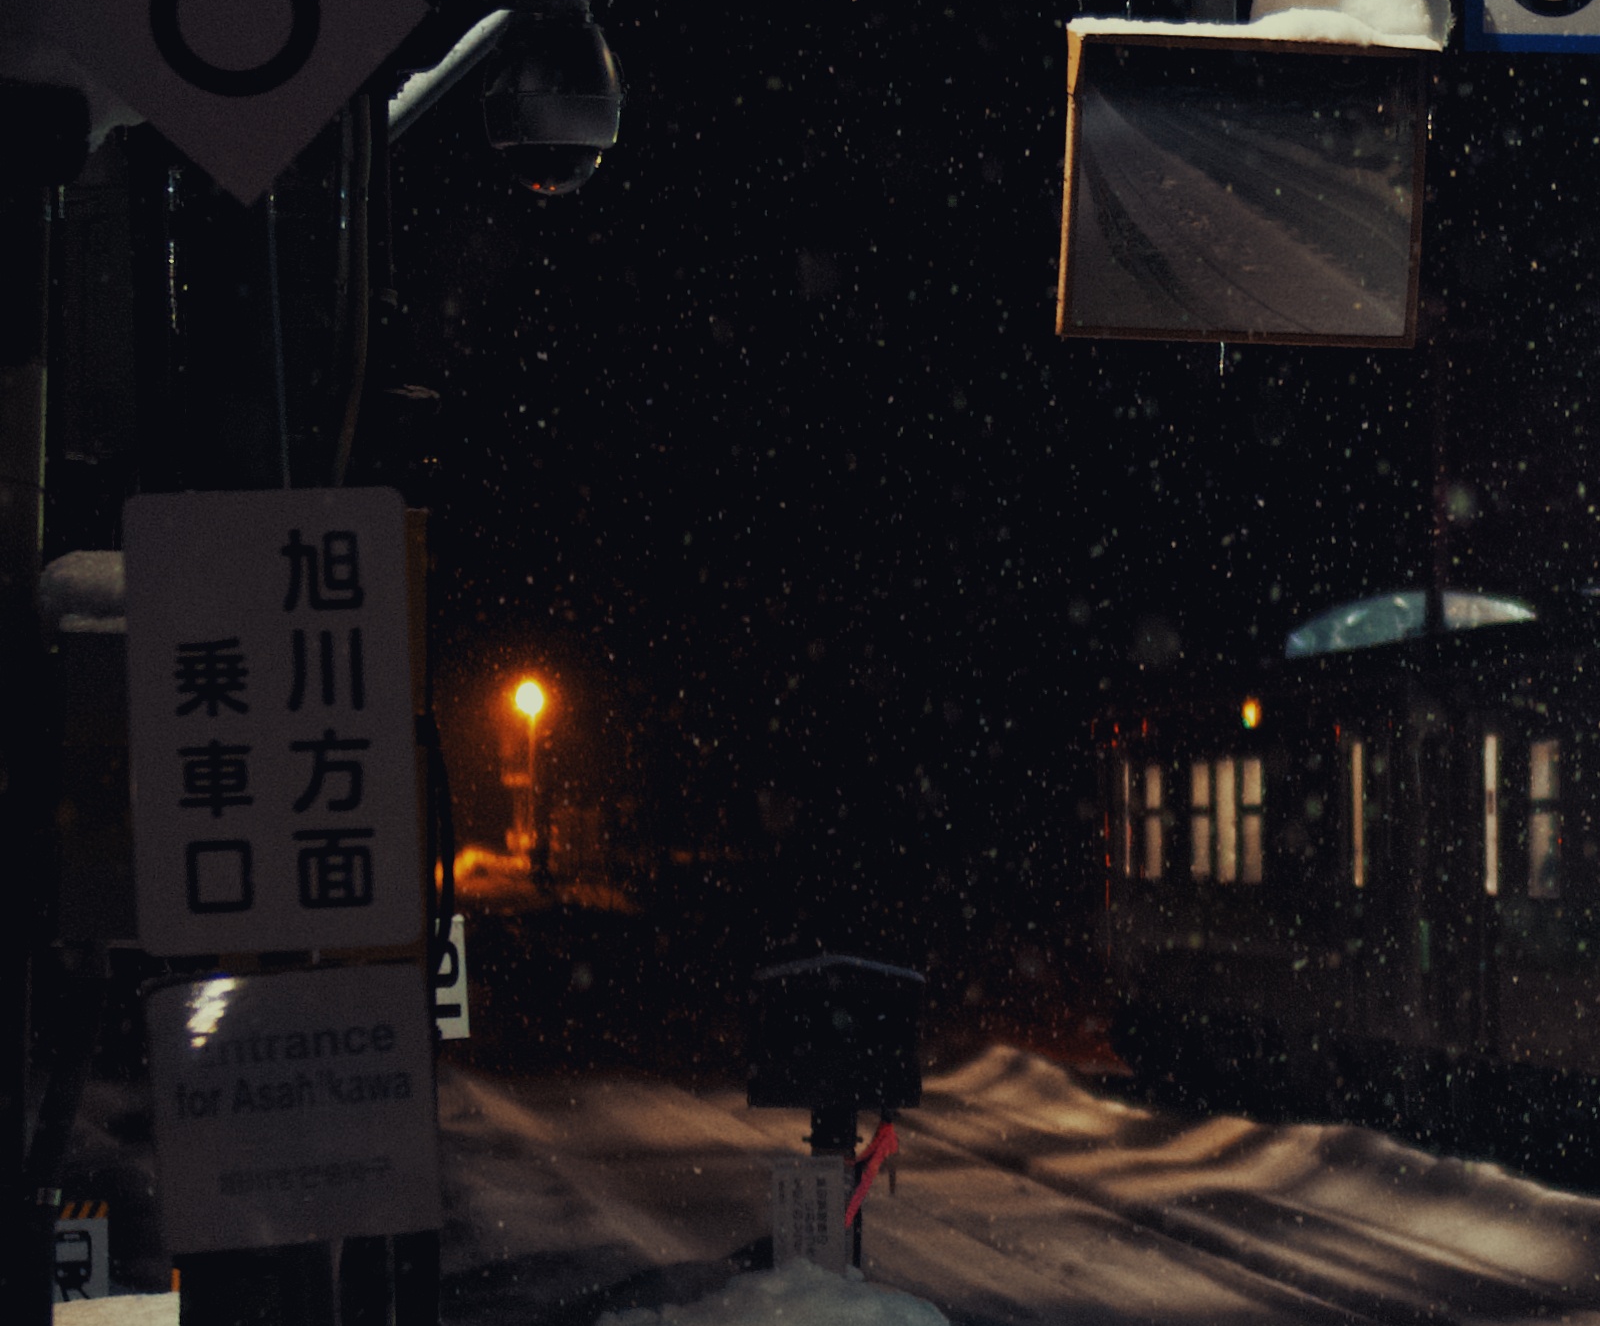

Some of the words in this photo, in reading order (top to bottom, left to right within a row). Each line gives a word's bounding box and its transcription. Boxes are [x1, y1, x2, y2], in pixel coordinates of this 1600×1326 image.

[174, 637, 254, 915] 乗車口
[281, 529, 374, 909] 旭川方面
[175, 1080, 222, 1118] for
